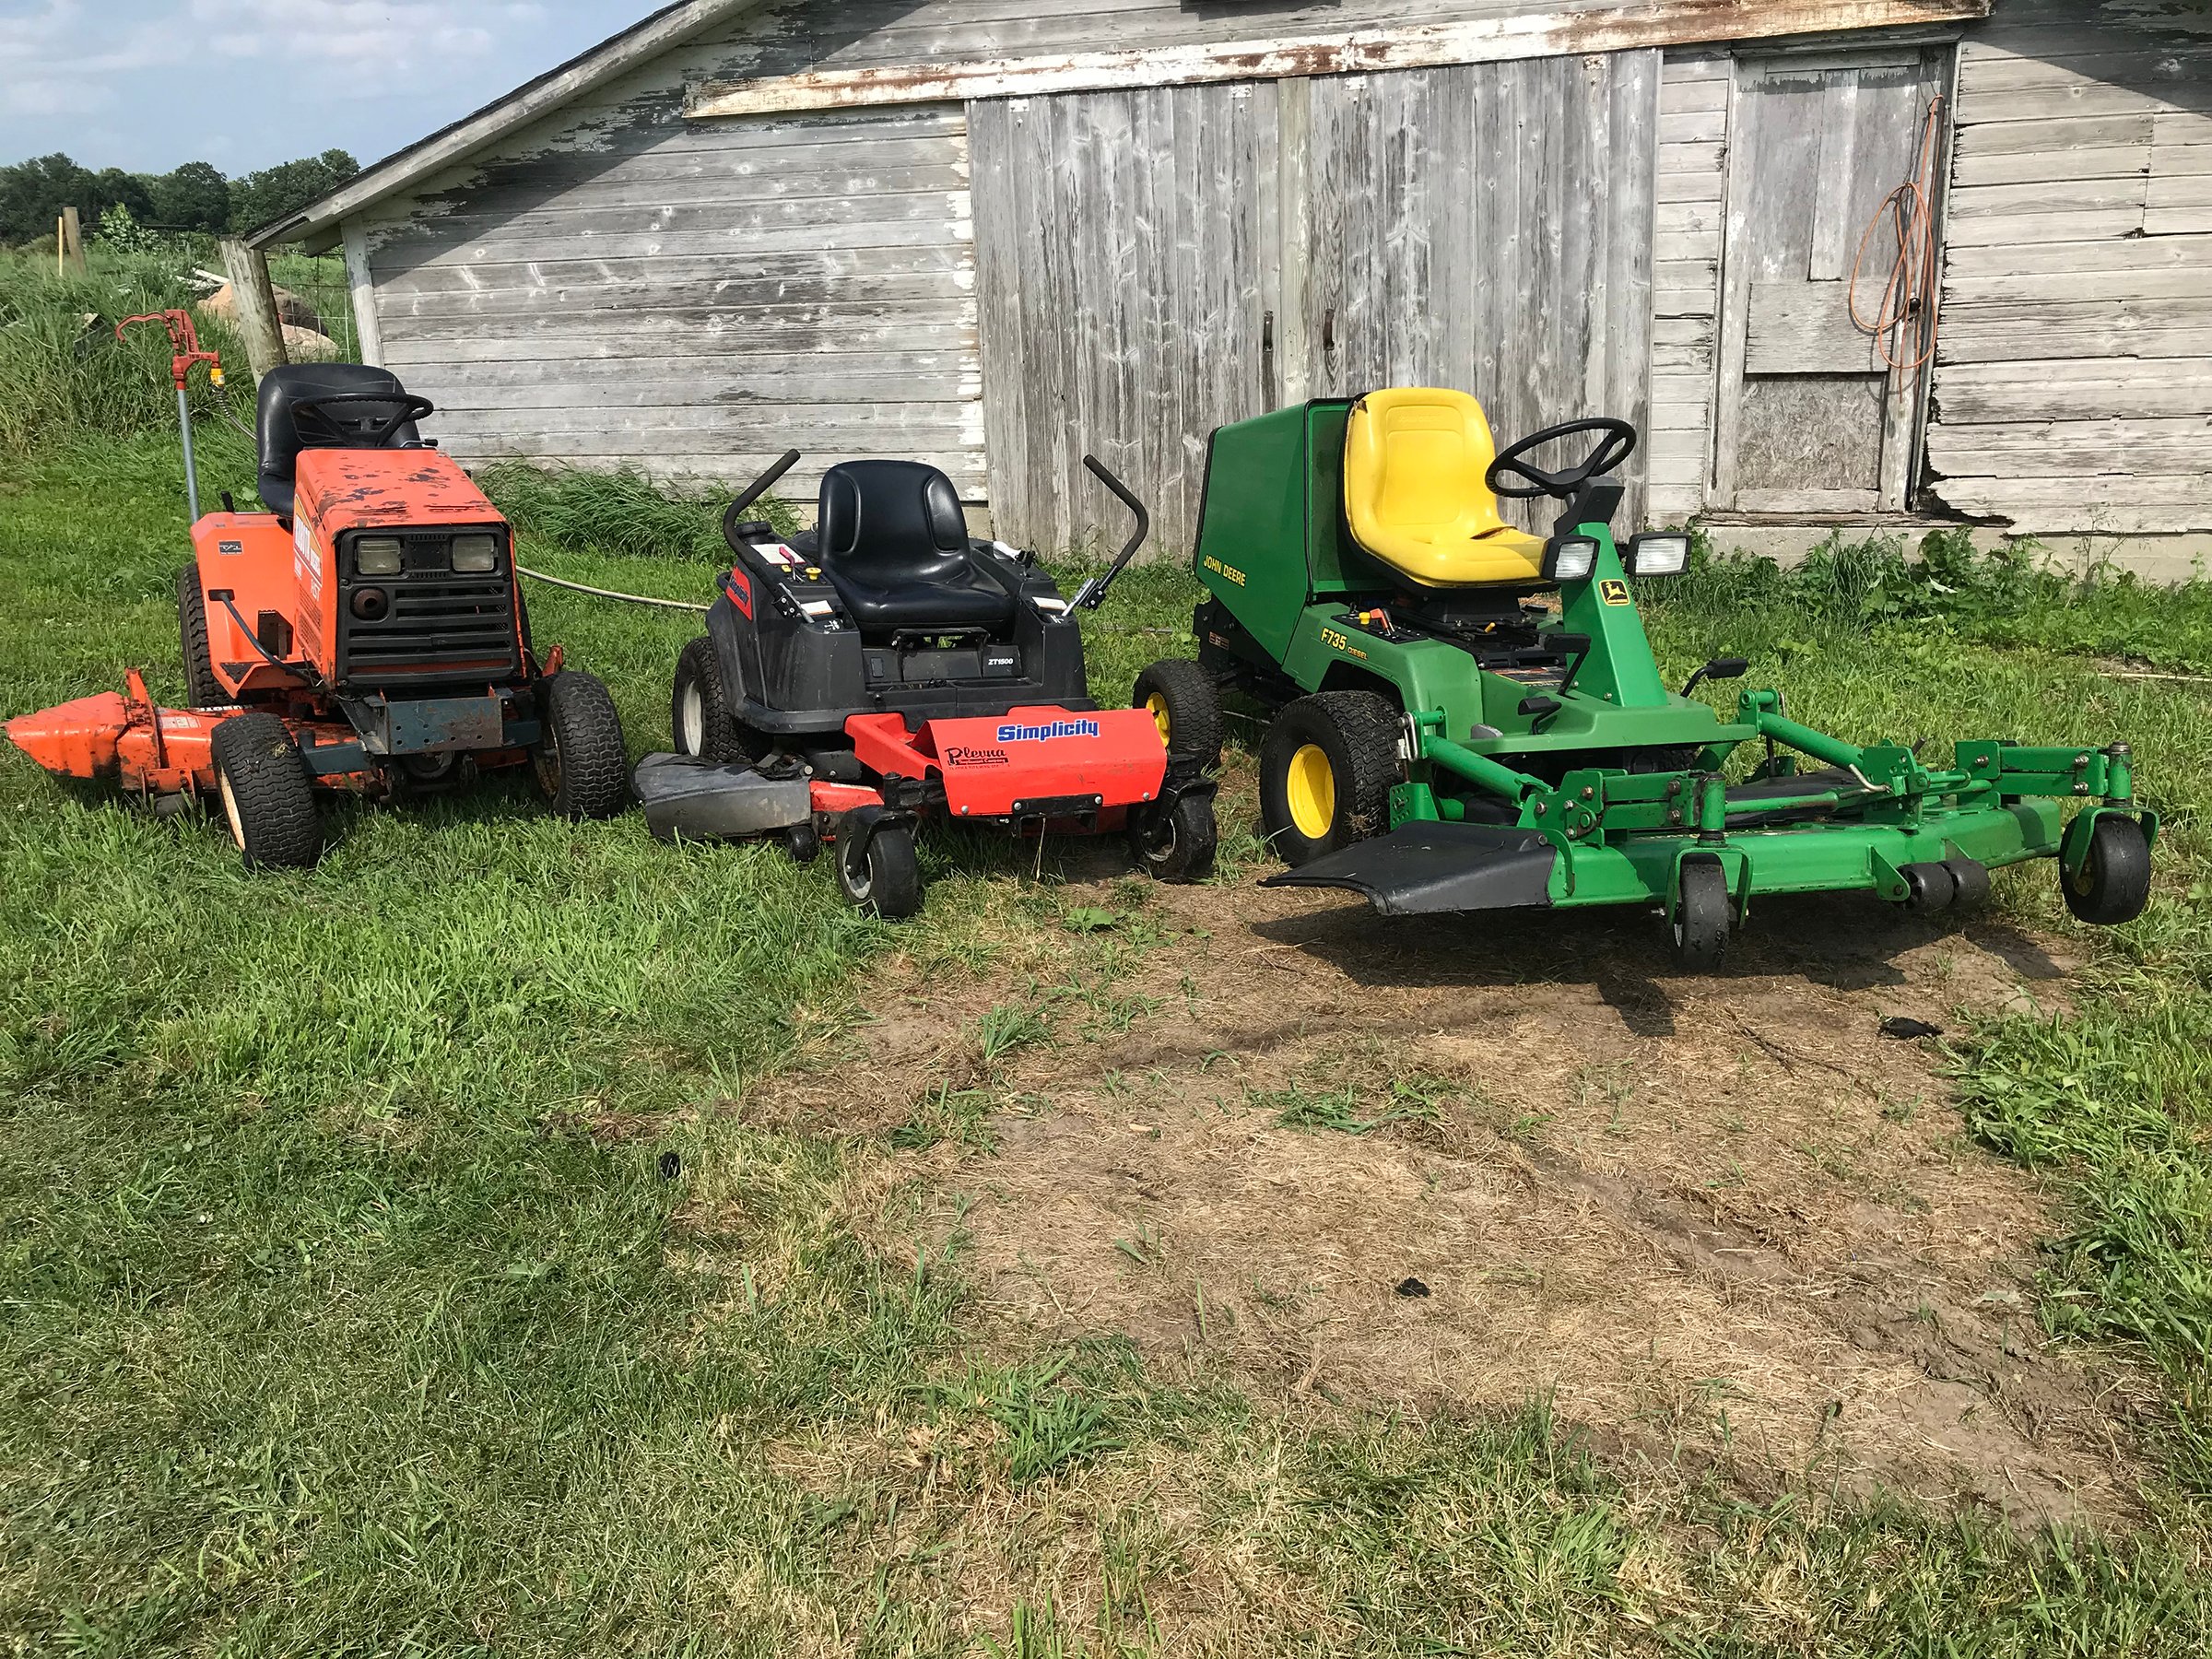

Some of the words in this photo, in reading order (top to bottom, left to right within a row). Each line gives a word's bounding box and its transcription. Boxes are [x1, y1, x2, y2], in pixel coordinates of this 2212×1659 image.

[1203, 554, 1222, 574] JOHN
[1223, 564, 1246, 587] DEERE
[1321, 628, 1347, 651] F735
[1347, 646, 1368, 660] DIESEL
[997, 719, 1099, 742] Simplicity
[945, 747, 1006, 764] Plevna
